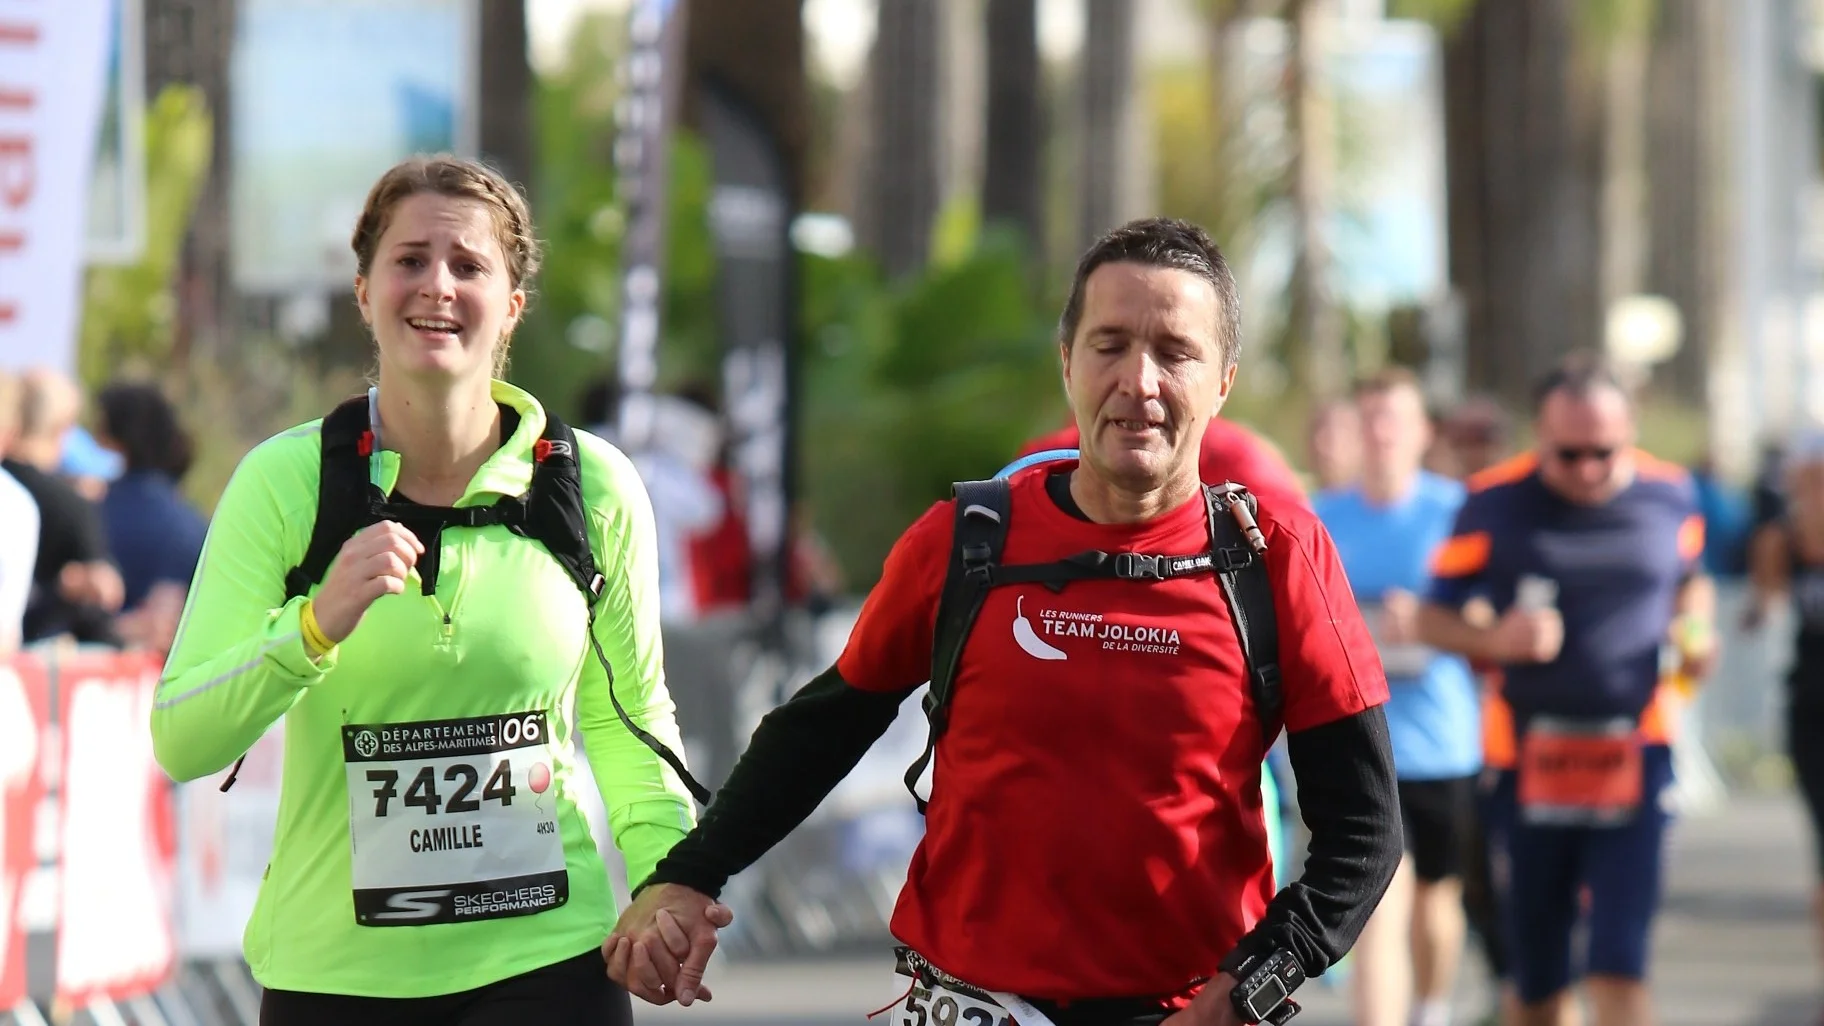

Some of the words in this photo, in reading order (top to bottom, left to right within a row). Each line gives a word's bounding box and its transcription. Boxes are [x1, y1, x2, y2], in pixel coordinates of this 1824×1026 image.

[1039, 609, 1057, 618] LES
[1059, 611, 1103, 622] RUNNERS
[1043, 620, 1095, 638] TEAM
[1098, 624, 1181, 645] JOLOKIA
[1102, 641, 1116, 650] DE
[1117, 642, 1129, 651] LA
[1131, 643, 1179, 655] DIVERSITÉ
[381, 722, 495, 742] DÉPARTEMENT
[503, 714, 540, 745] 06
[383, 743, 402, 753] DES
[405, 735, 496, 752] ALPES-MARITIMES
[365, 759, 516, 817] 7424
[410, 824, 483, 852] CAMILLE
[536, 821, 555, 835] 4H30
[453, 884, 556, 908] SKECHERS
[455, 896, 556, 916] PERFORMANCE
